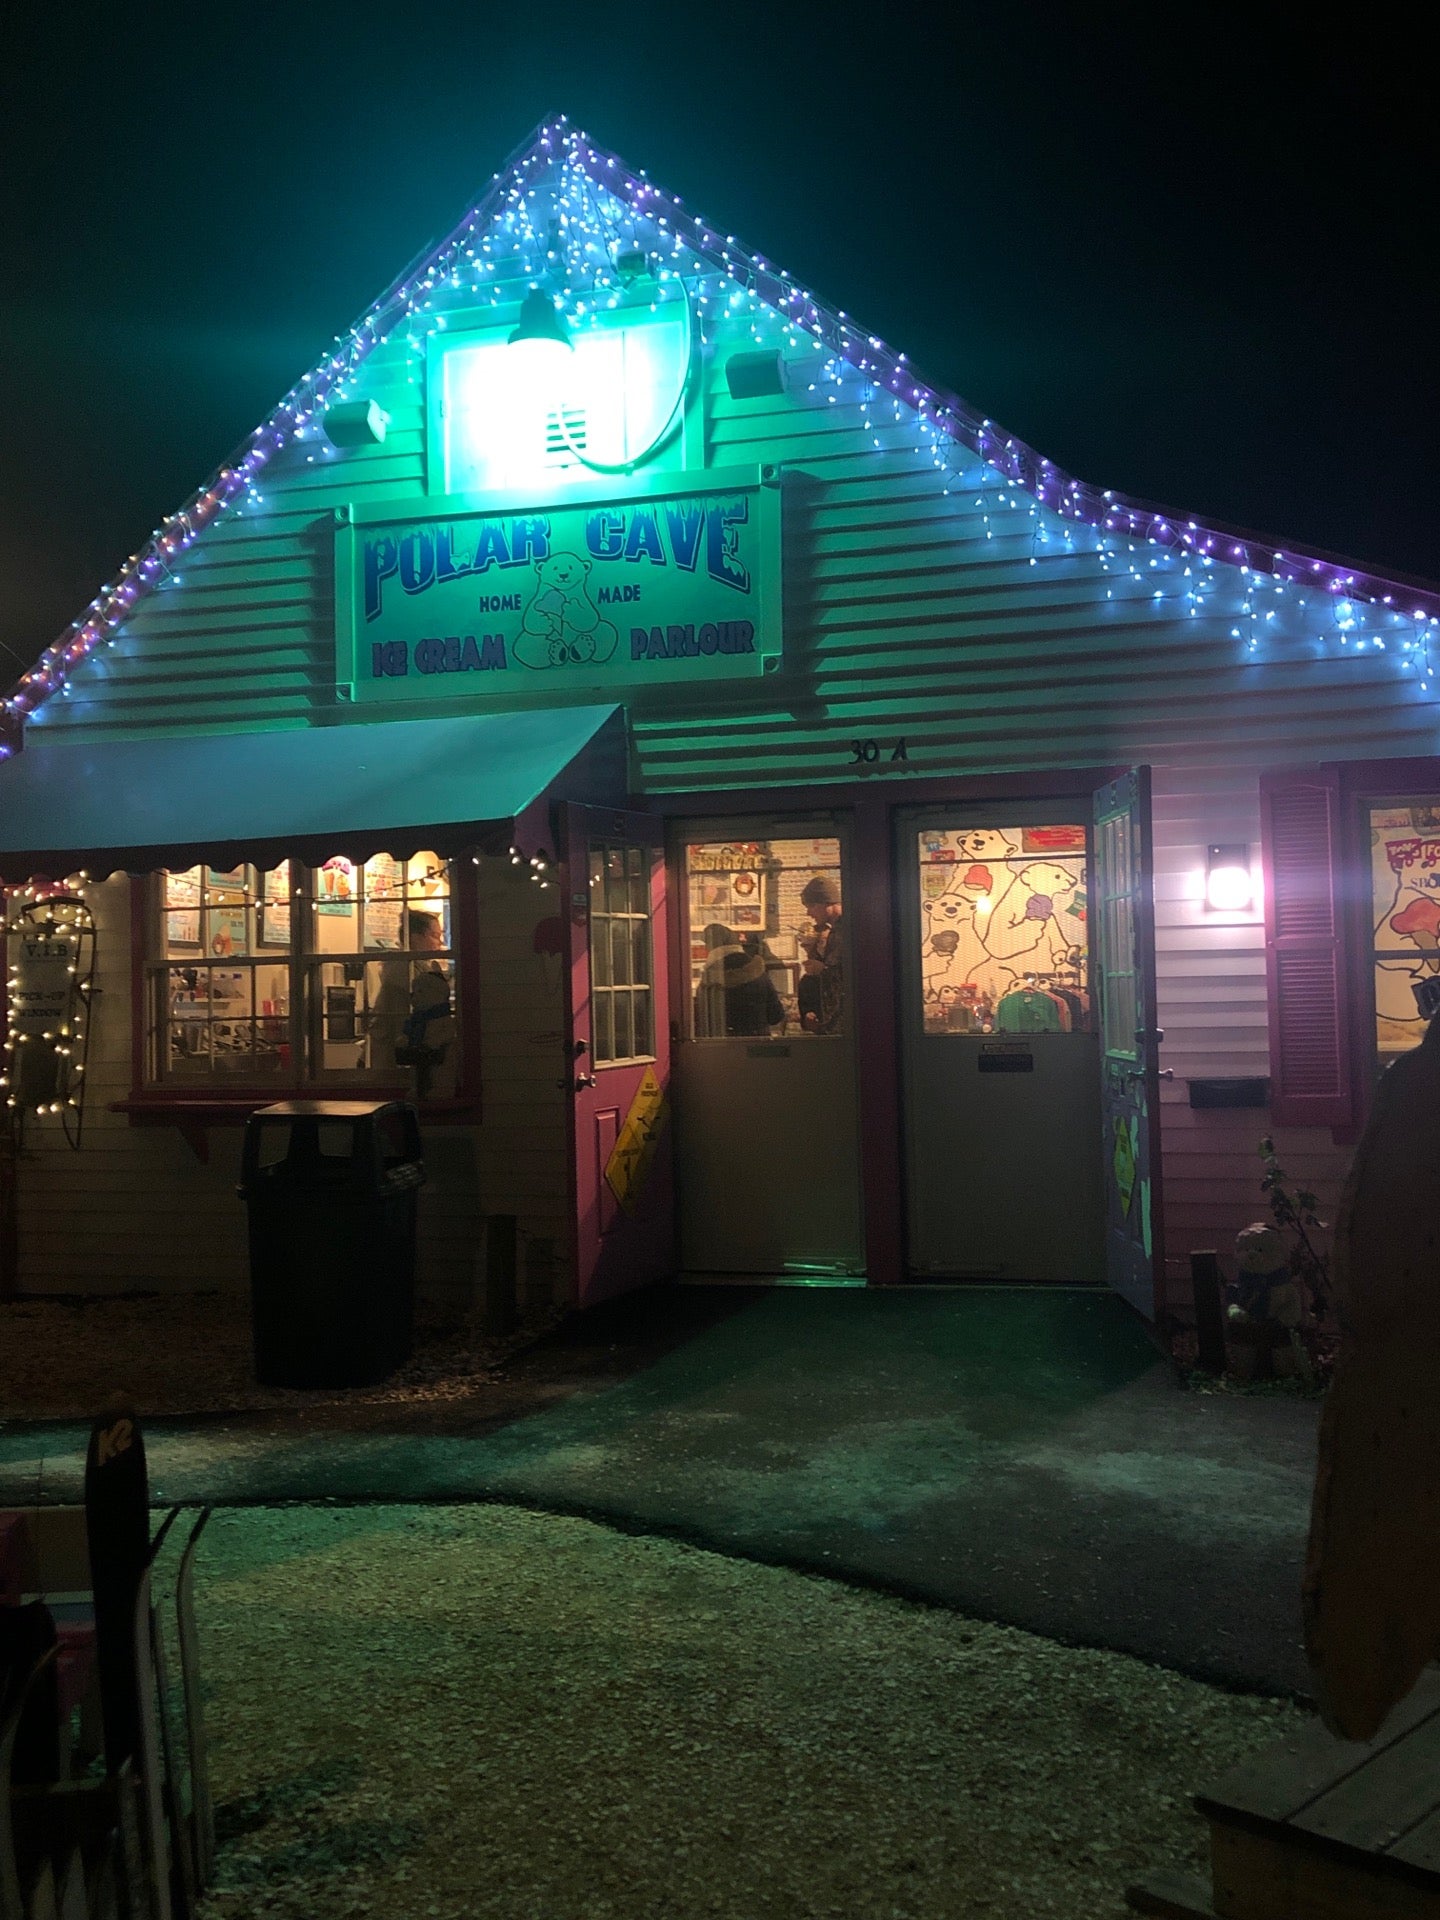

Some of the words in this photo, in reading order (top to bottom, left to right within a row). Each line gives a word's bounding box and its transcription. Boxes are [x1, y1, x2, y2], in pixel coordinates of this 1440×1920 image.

[364, 513, 550, 623] POLAR
[586, 494, 750, 594] CAVE
[480, 594, 521, 612] HOME
[598, 584, 641, 604] MADE
[372, 640, 408, 677] ICE
[414, 633, 507, 674] CREAM
[630, 620, 755, 660] PARLOUR
